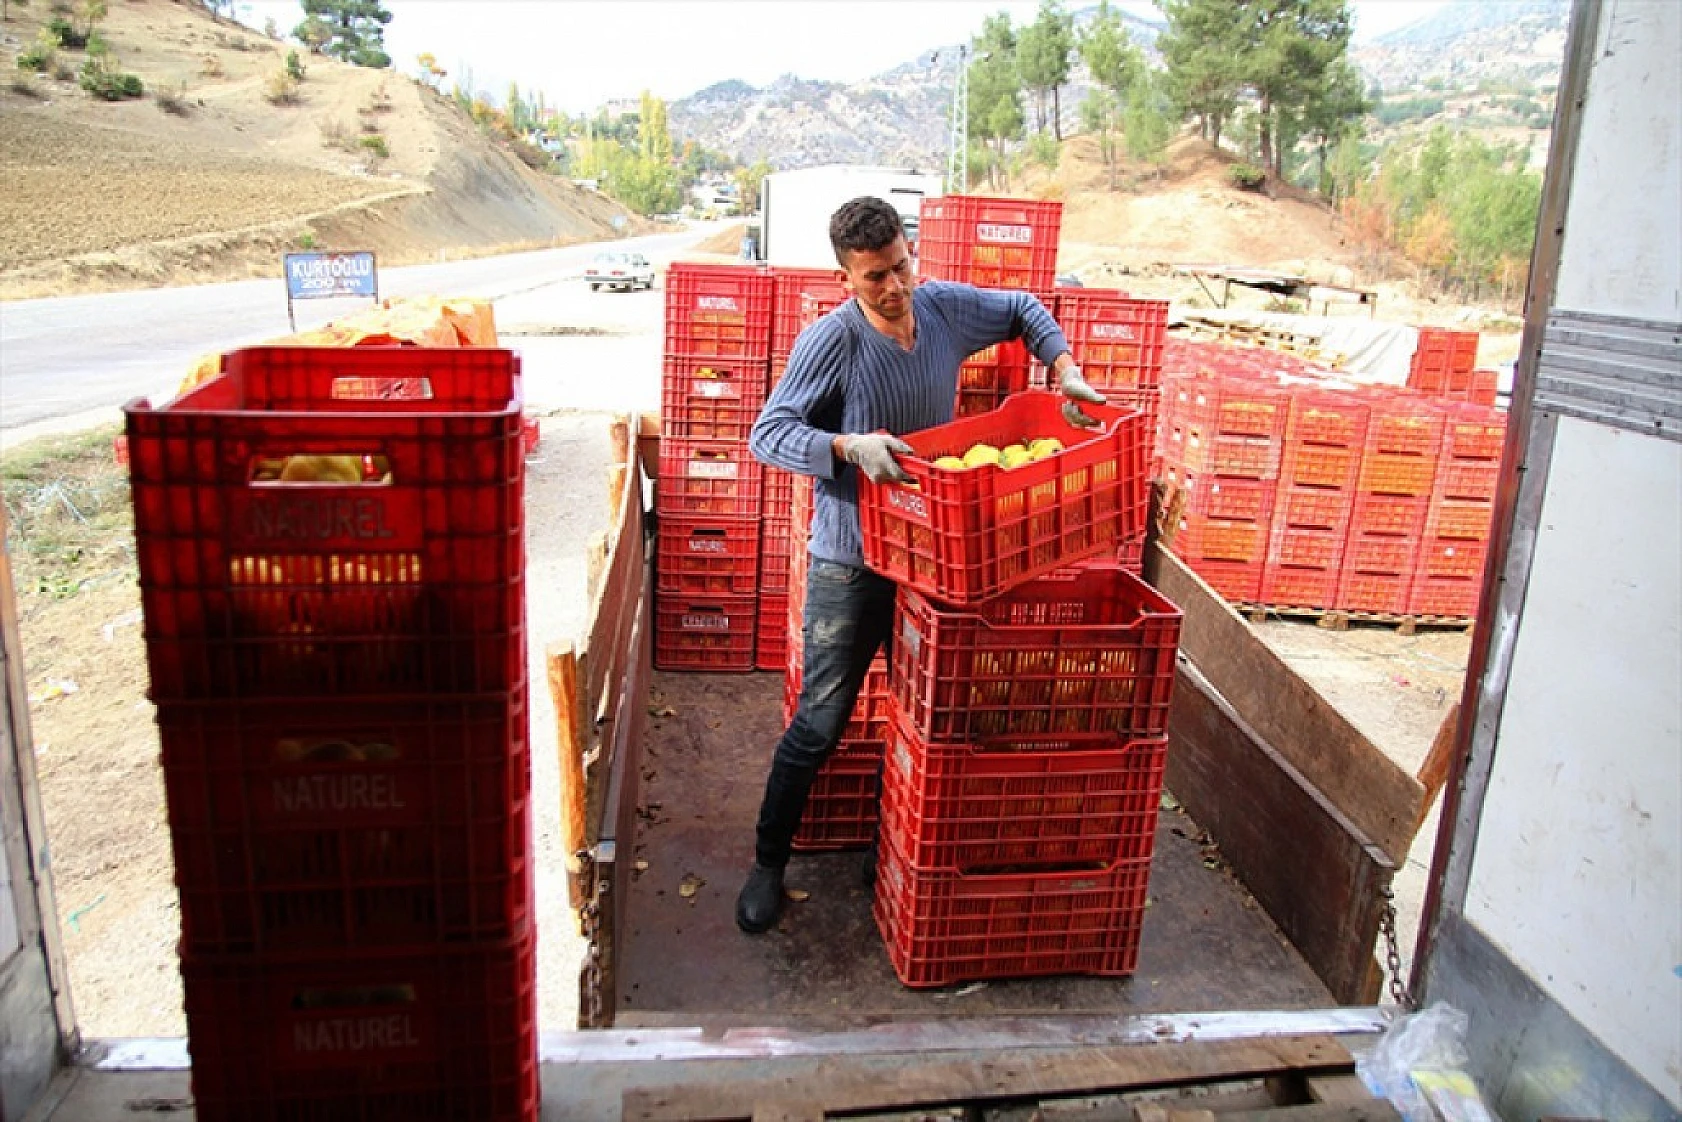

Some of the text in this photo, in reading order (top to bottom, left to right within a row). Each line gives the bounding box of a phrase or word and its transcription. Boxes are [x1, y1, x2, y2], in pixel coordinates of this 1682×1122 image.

[977, 225, 1032, 241] NATUREL
[697, 296, 738, 311] NATUREL
[1093, 324, 1135, 339] NATUREL
[889, 489, 927, 518] NATUREL
[250, 498, 394, 538] NATUREL
[689, 539, 728, 553] NATUREL
[272, 773, 406, 812] NATUREL
[293, 1014, 419, 1051] NATUREL
